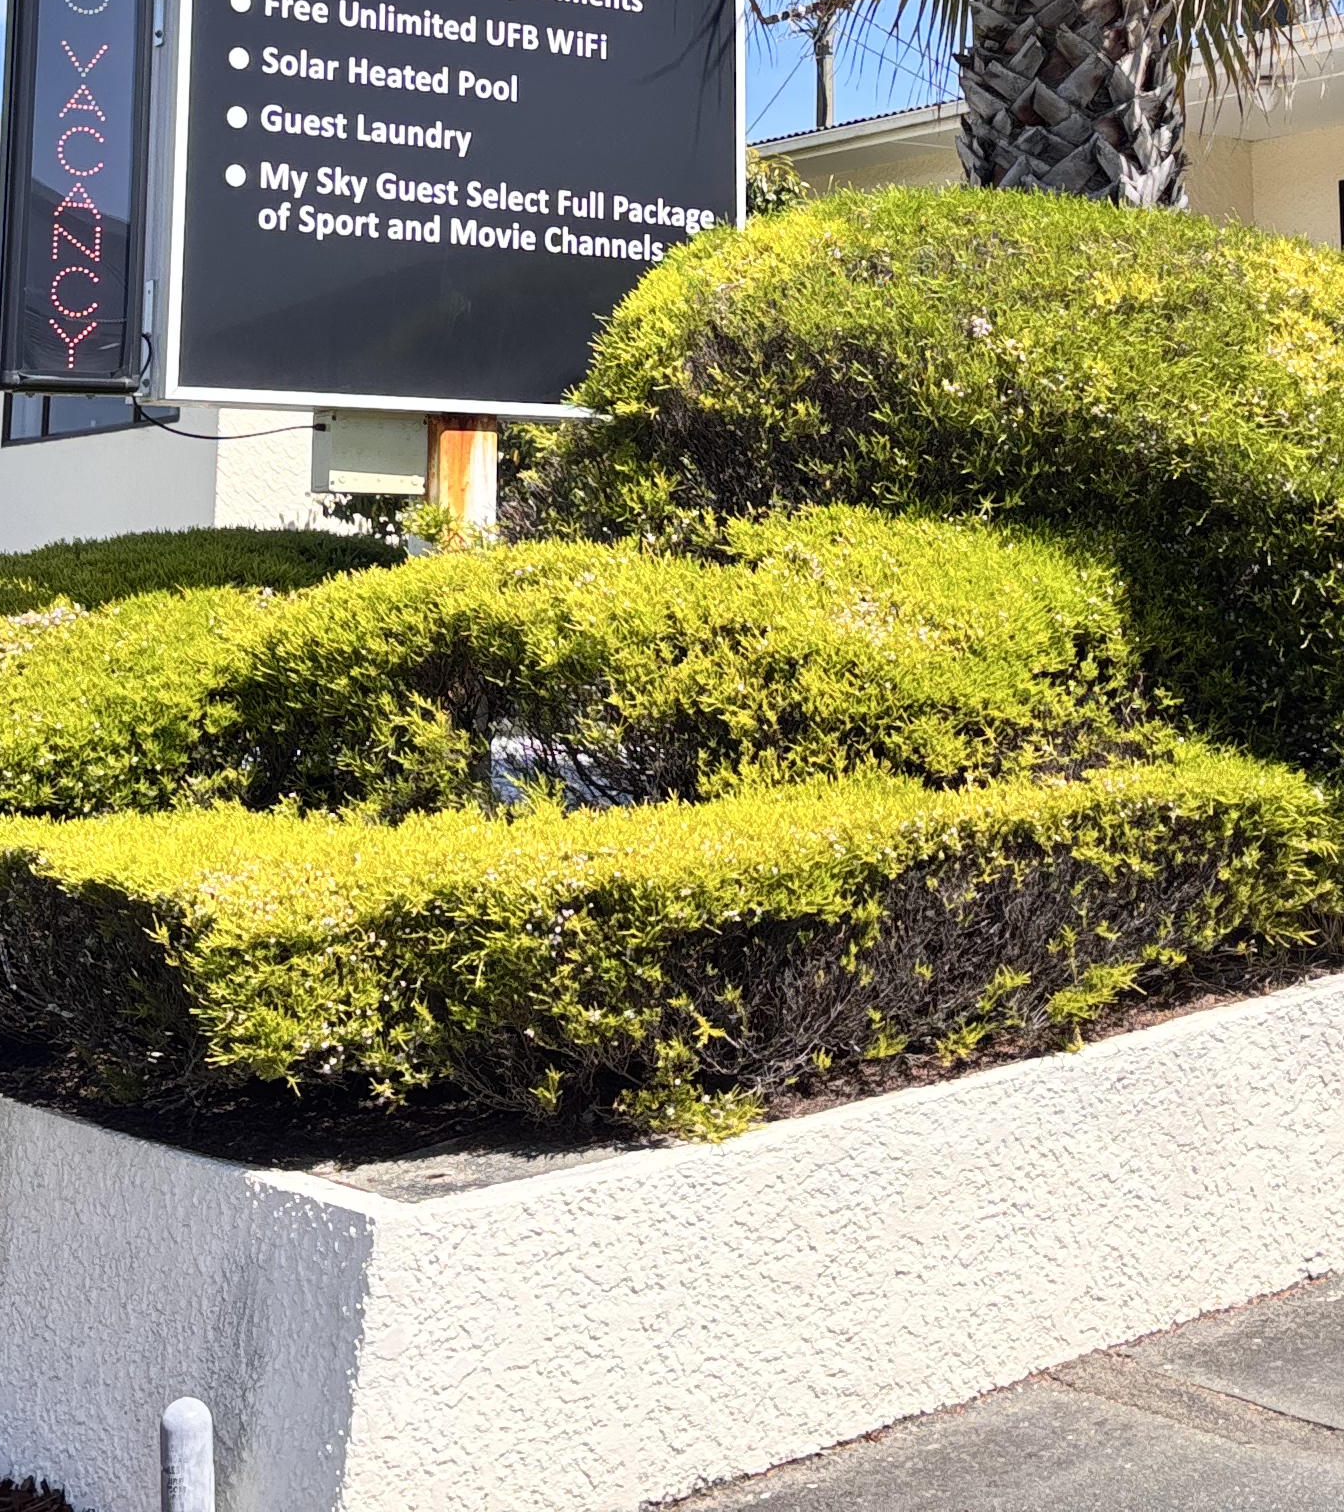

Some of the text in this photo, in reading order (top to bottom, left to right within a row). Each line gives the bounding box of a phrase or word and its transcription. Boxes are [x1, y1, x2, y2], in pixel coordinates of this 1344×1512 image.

[339, 0, 477, 43] Unlimited
[486, 19, 539, 50] UFB
[546, 27, 608, 60] WiFi
[261, 46, 518, 102] Solar Heated Pool
[260, 104, 472, 158] Guest Laundry
[50, 39, 110, 369] VACANCY
[259, 161, 715, 235] My Sky Guest Select Full Package
[258, 201, 664, 262] of Sport and Movie Channels
